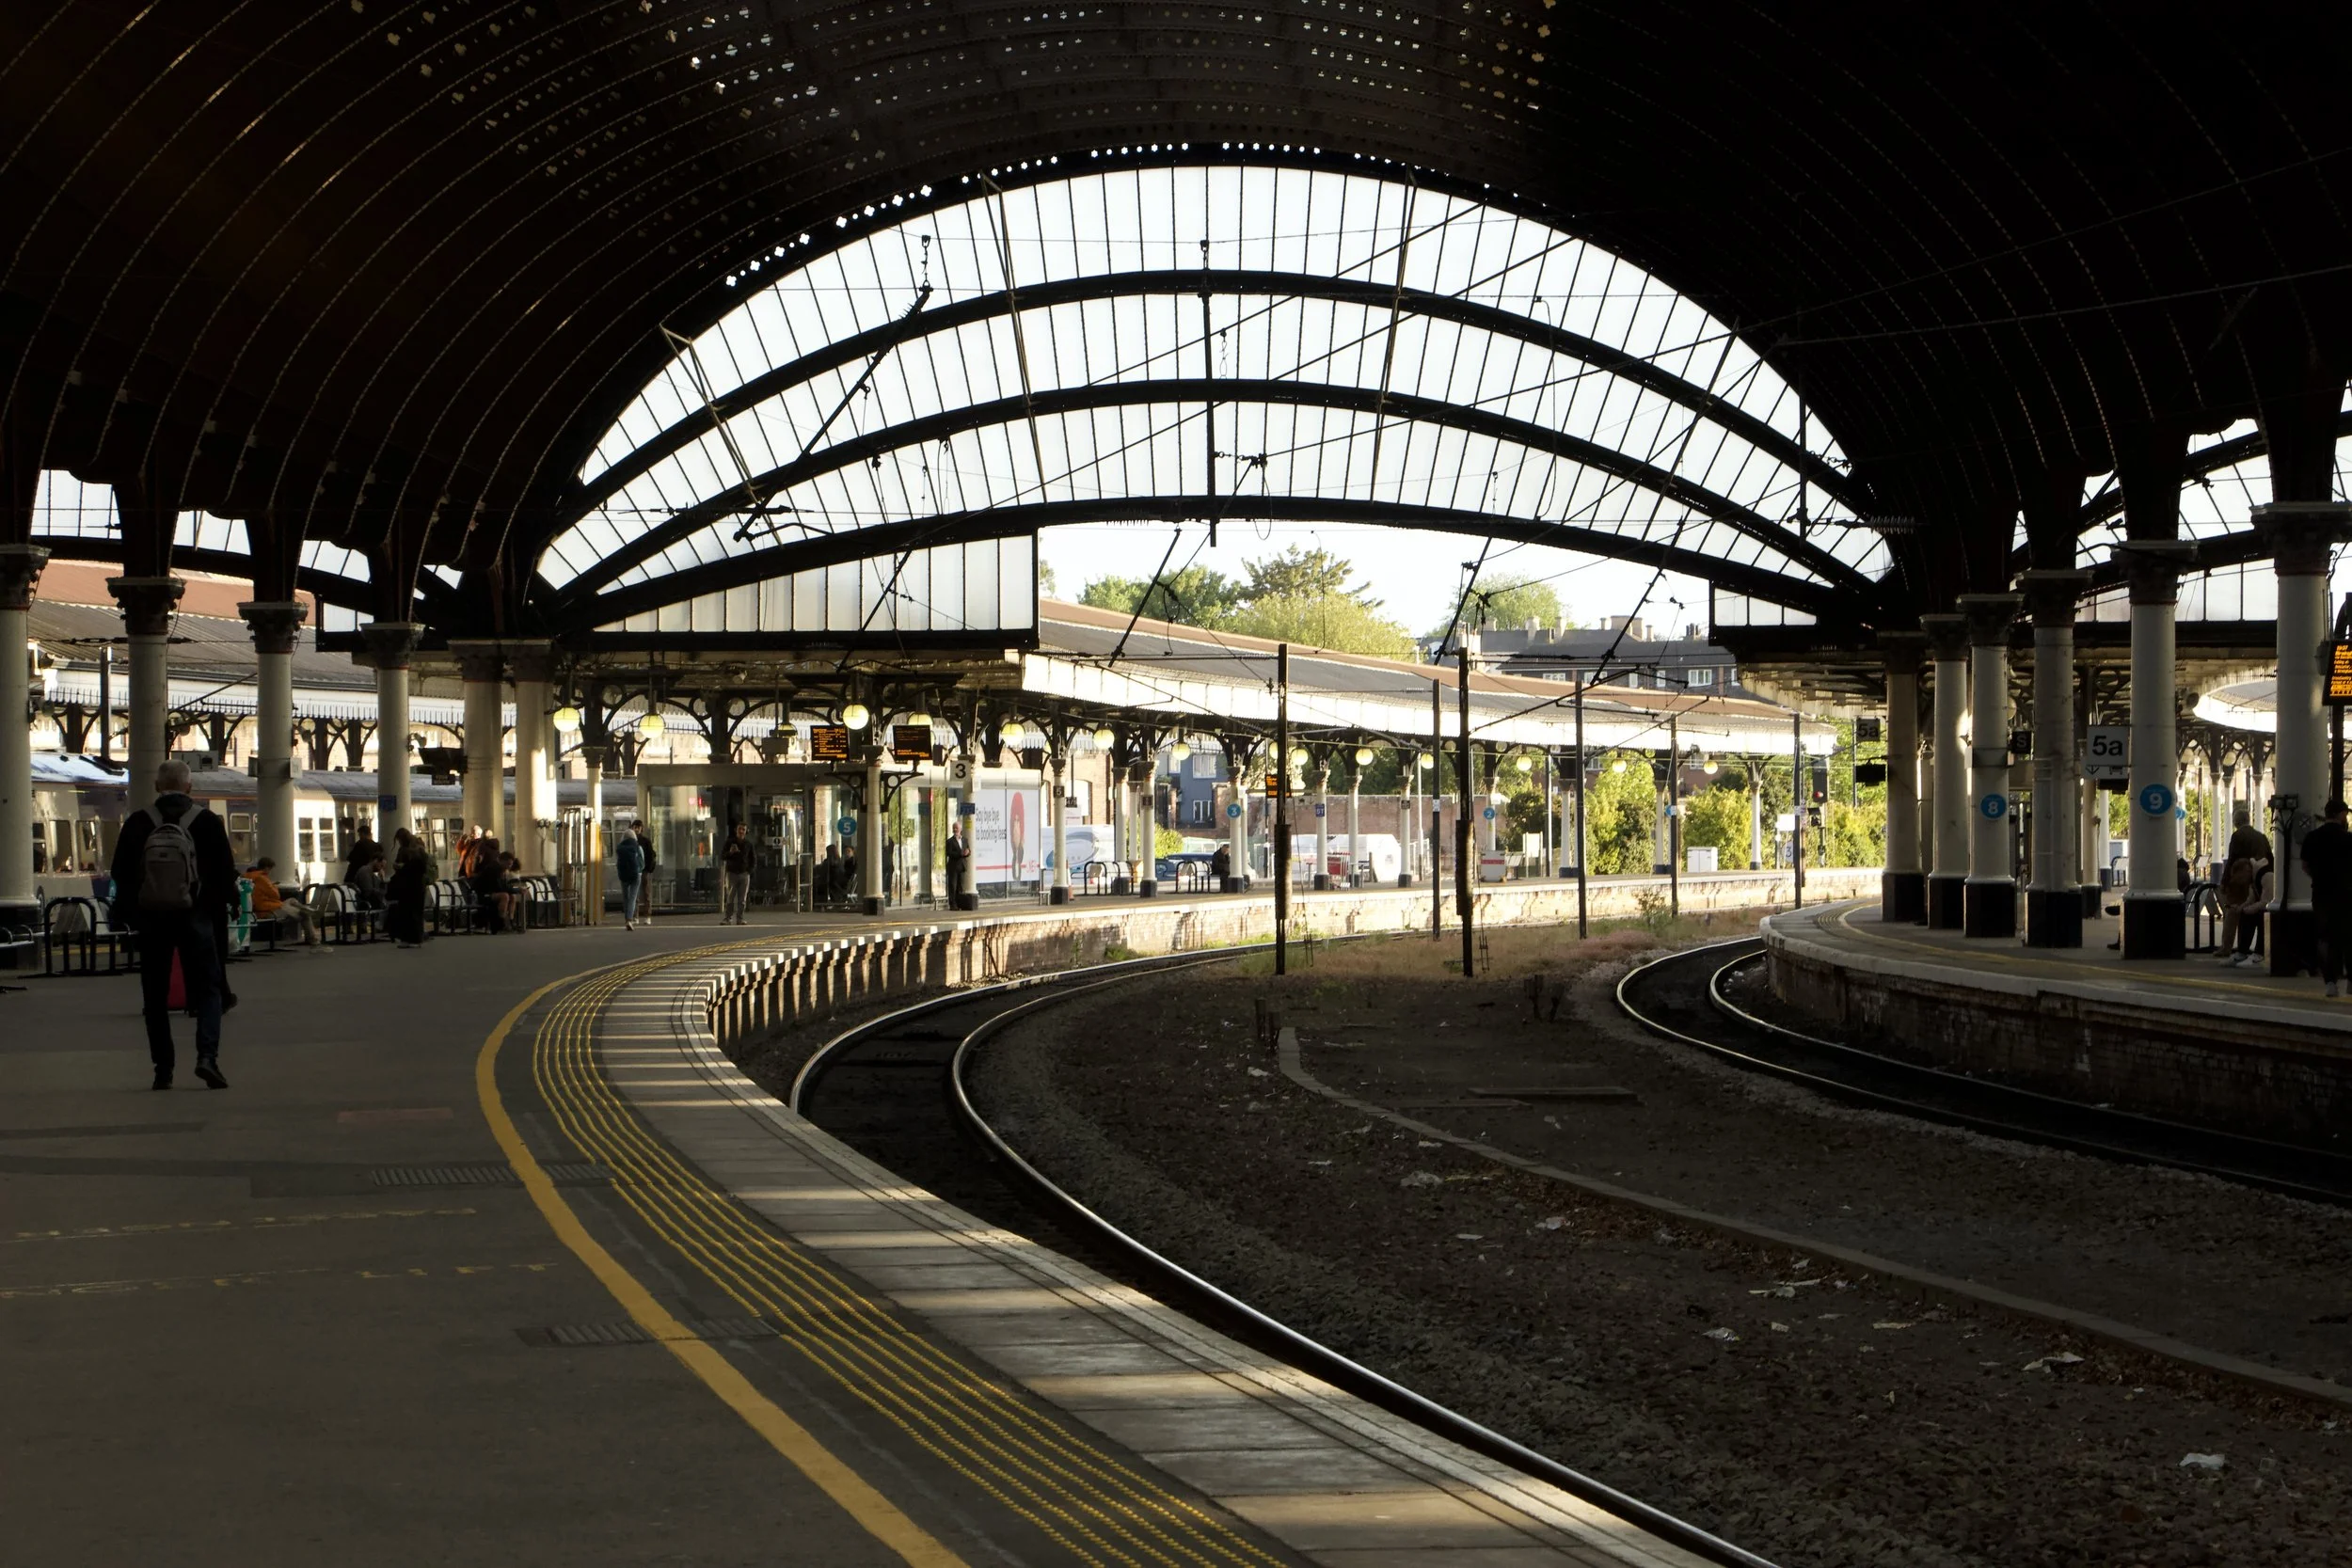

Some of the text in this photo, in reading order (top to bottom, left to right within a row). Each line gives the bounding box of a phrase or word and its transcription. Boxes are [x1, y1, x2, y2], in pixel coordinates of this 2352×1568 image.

[1858, 723, 1879, 737] 5a
[2091, 735, 2123, 756] 5a
[955, 763, 966, 779] 3
[1988, 800, 1999, 815] 8
[2149, 792, 2163, 810] 9
[843, 822, 851, 831] 5
[1786, 847, 1792, 858] 3
